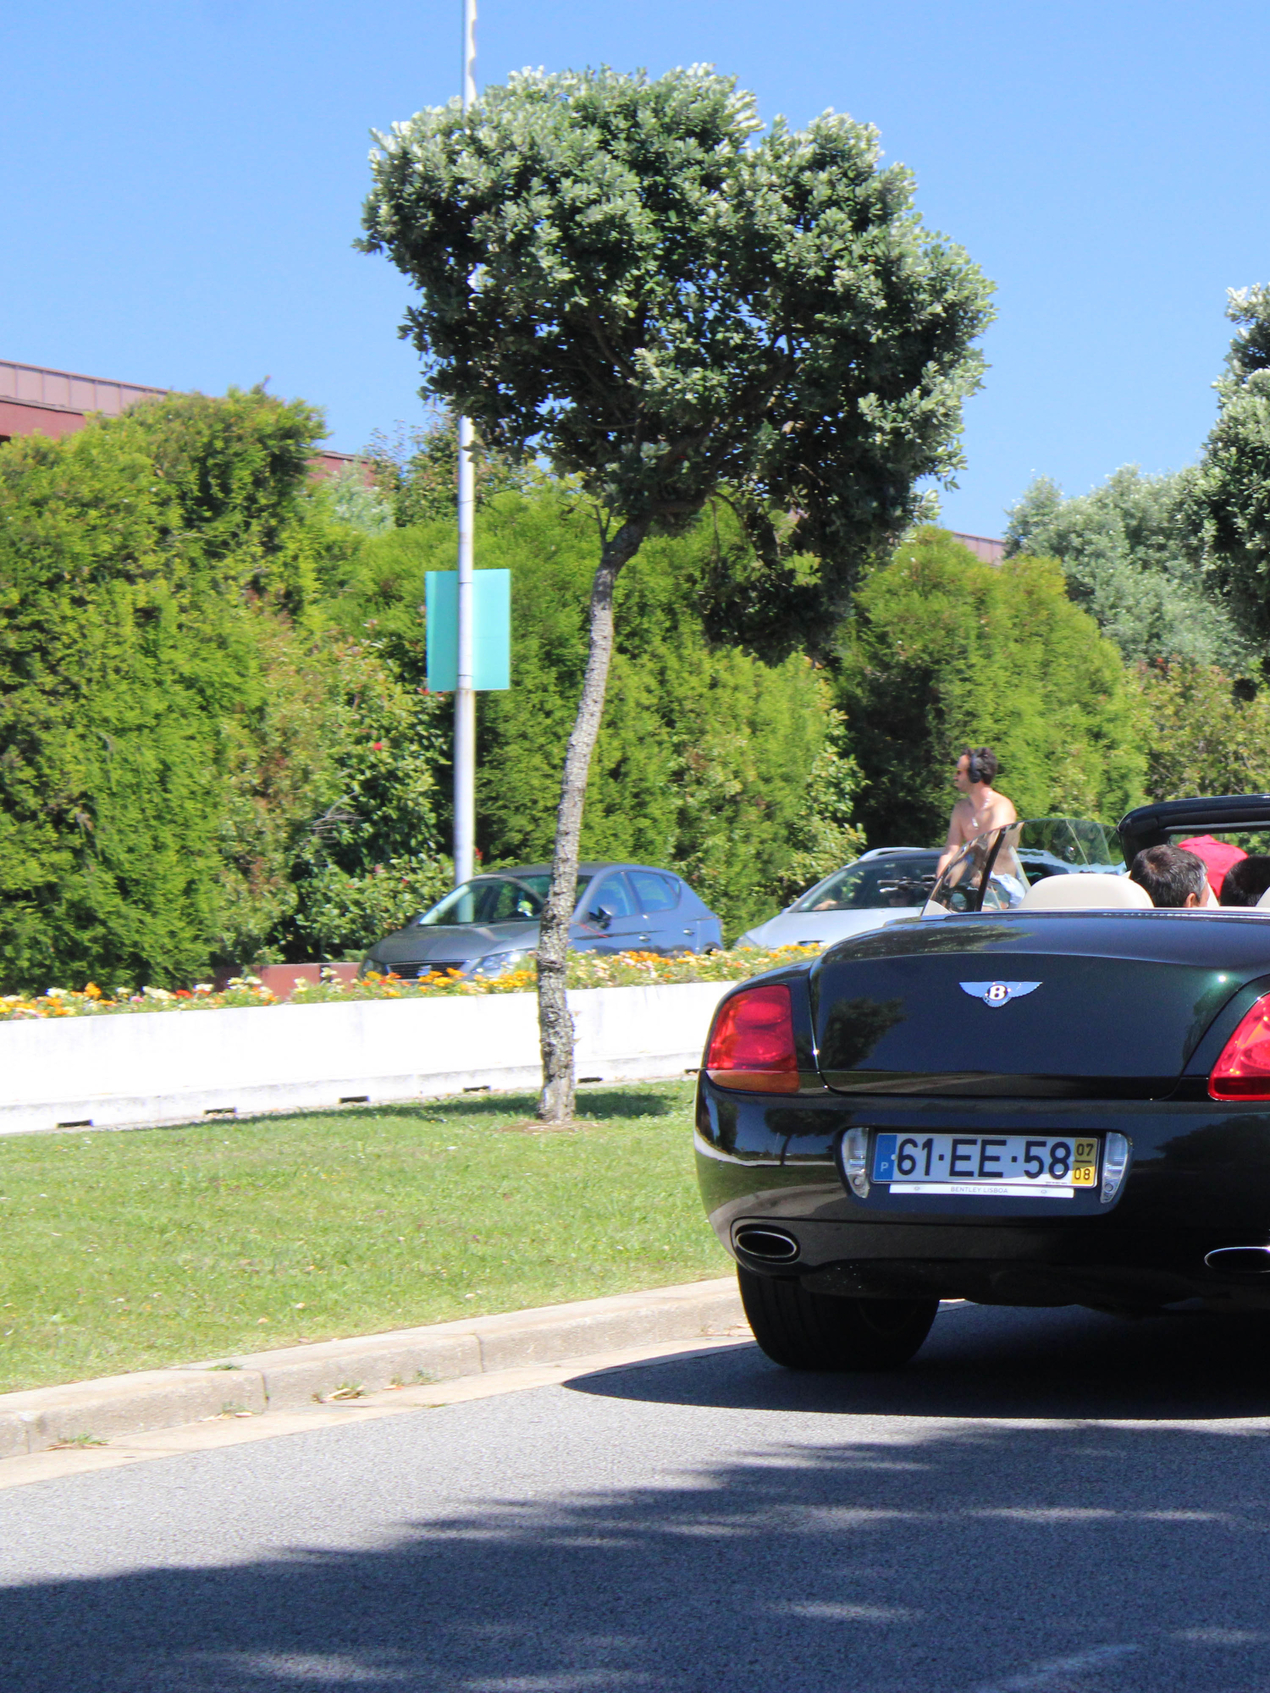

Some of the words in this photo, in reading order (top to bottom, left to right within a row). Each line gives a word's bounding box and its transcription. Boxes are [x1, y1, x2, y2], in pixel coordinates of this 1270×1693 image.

[1076, 1143, 1094, 1157] 07
[880, 1162, 889, 1172] P
[1074, 1167, 1091, 1180] 08
